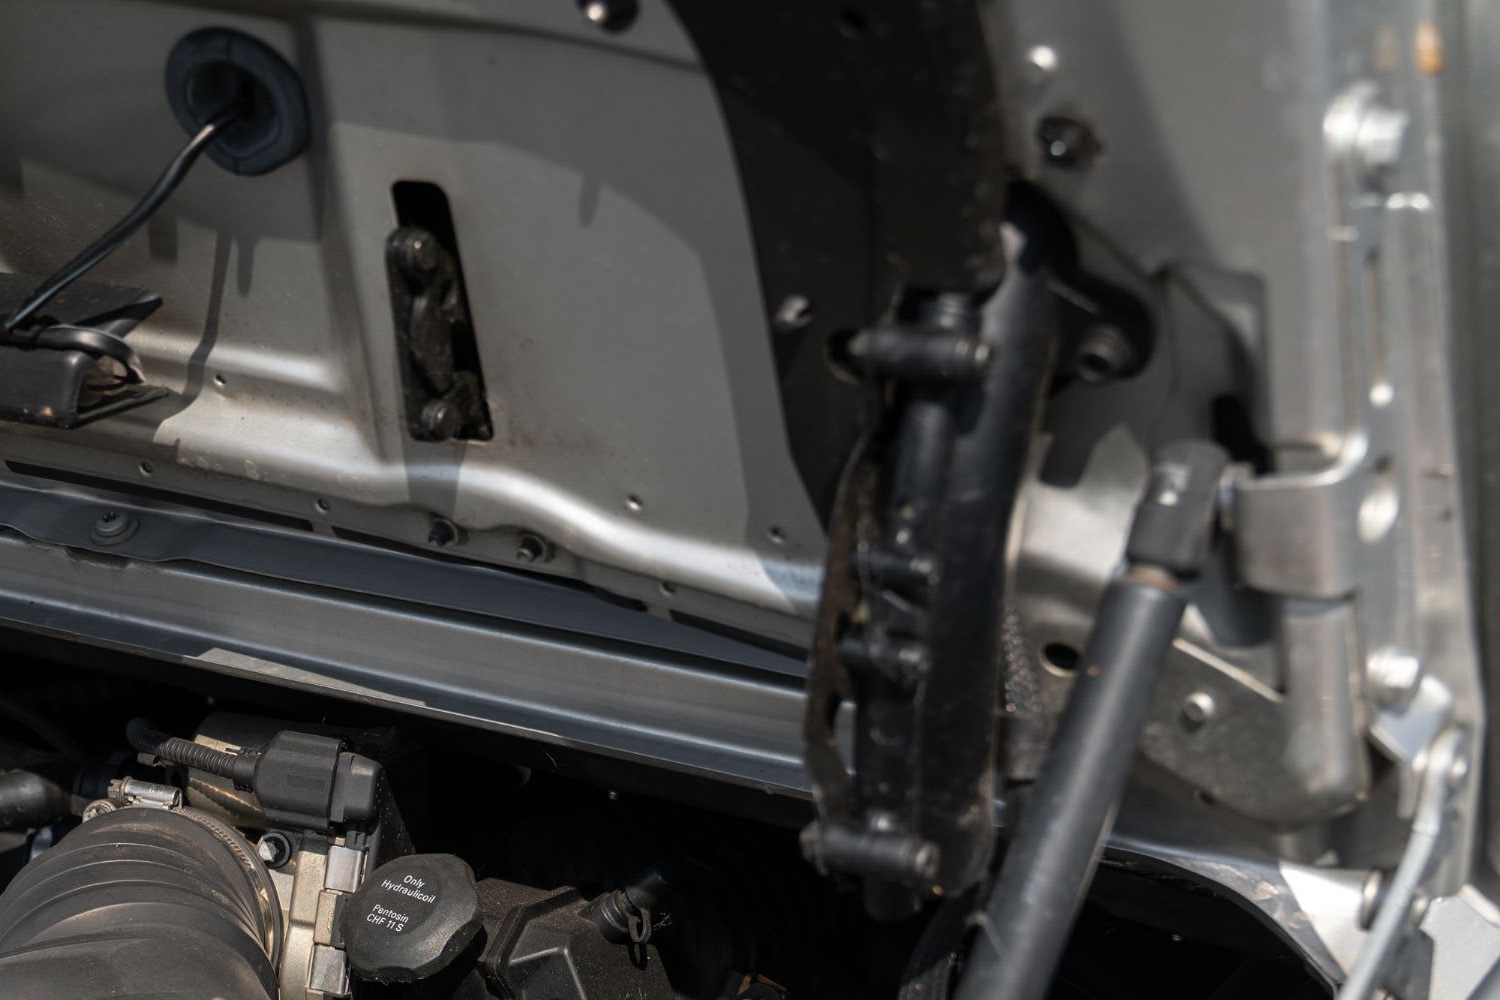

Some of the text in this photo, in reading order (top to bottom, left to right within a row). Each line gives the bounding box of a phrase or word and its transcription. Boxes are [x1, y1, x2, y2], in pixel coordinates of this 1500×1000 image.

[403, 874, 426, 888] Only
[381, 879, 436, 904] Hydraulicoil
[366, 913, 404, 932] CHF 11 S
[372, 904, 409, 923] Pentosin
